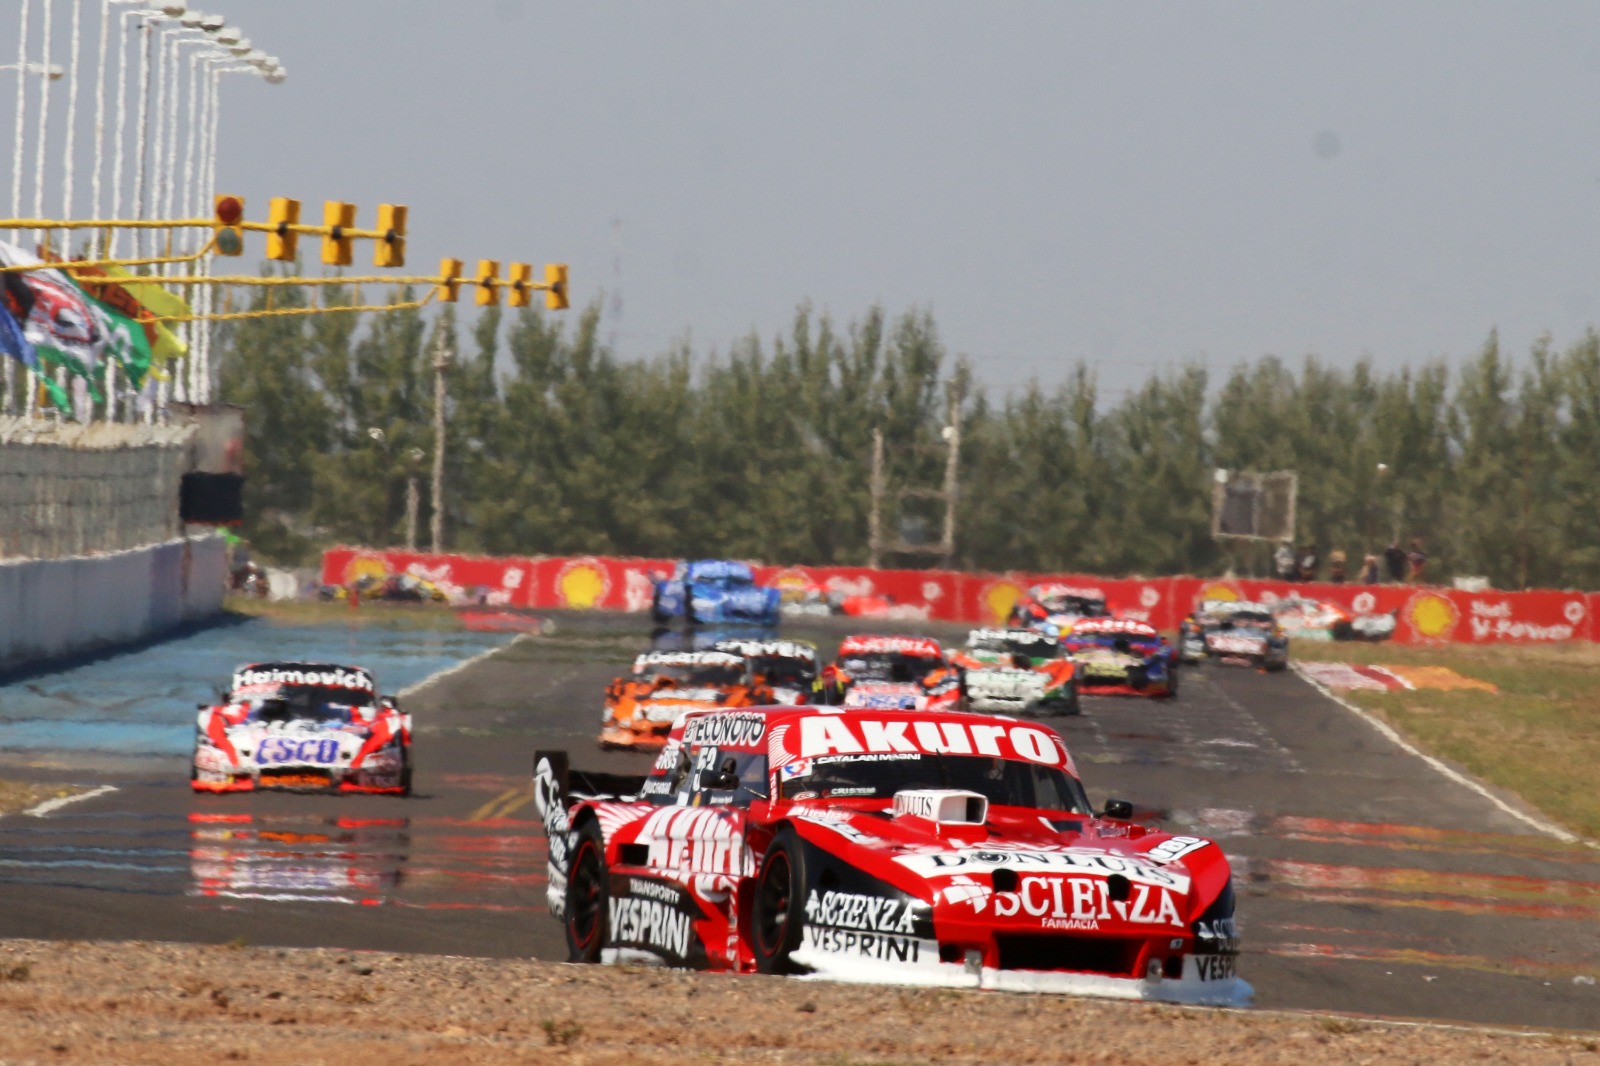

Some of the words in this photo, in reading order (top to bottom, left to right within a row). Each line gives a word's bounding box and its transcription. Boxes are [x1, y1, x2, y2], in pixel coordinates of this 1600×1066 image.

[232, 668, 374, 691] Haimovich
[800, 716, 1060, 765] Akuro
[816, 753, 879, 765] CATALAN
[608, 896, 691, 959] VESPRINI
[815, 890, 915, 934] SCIENZA
[810, 925, 920, 963] VESPRINI
